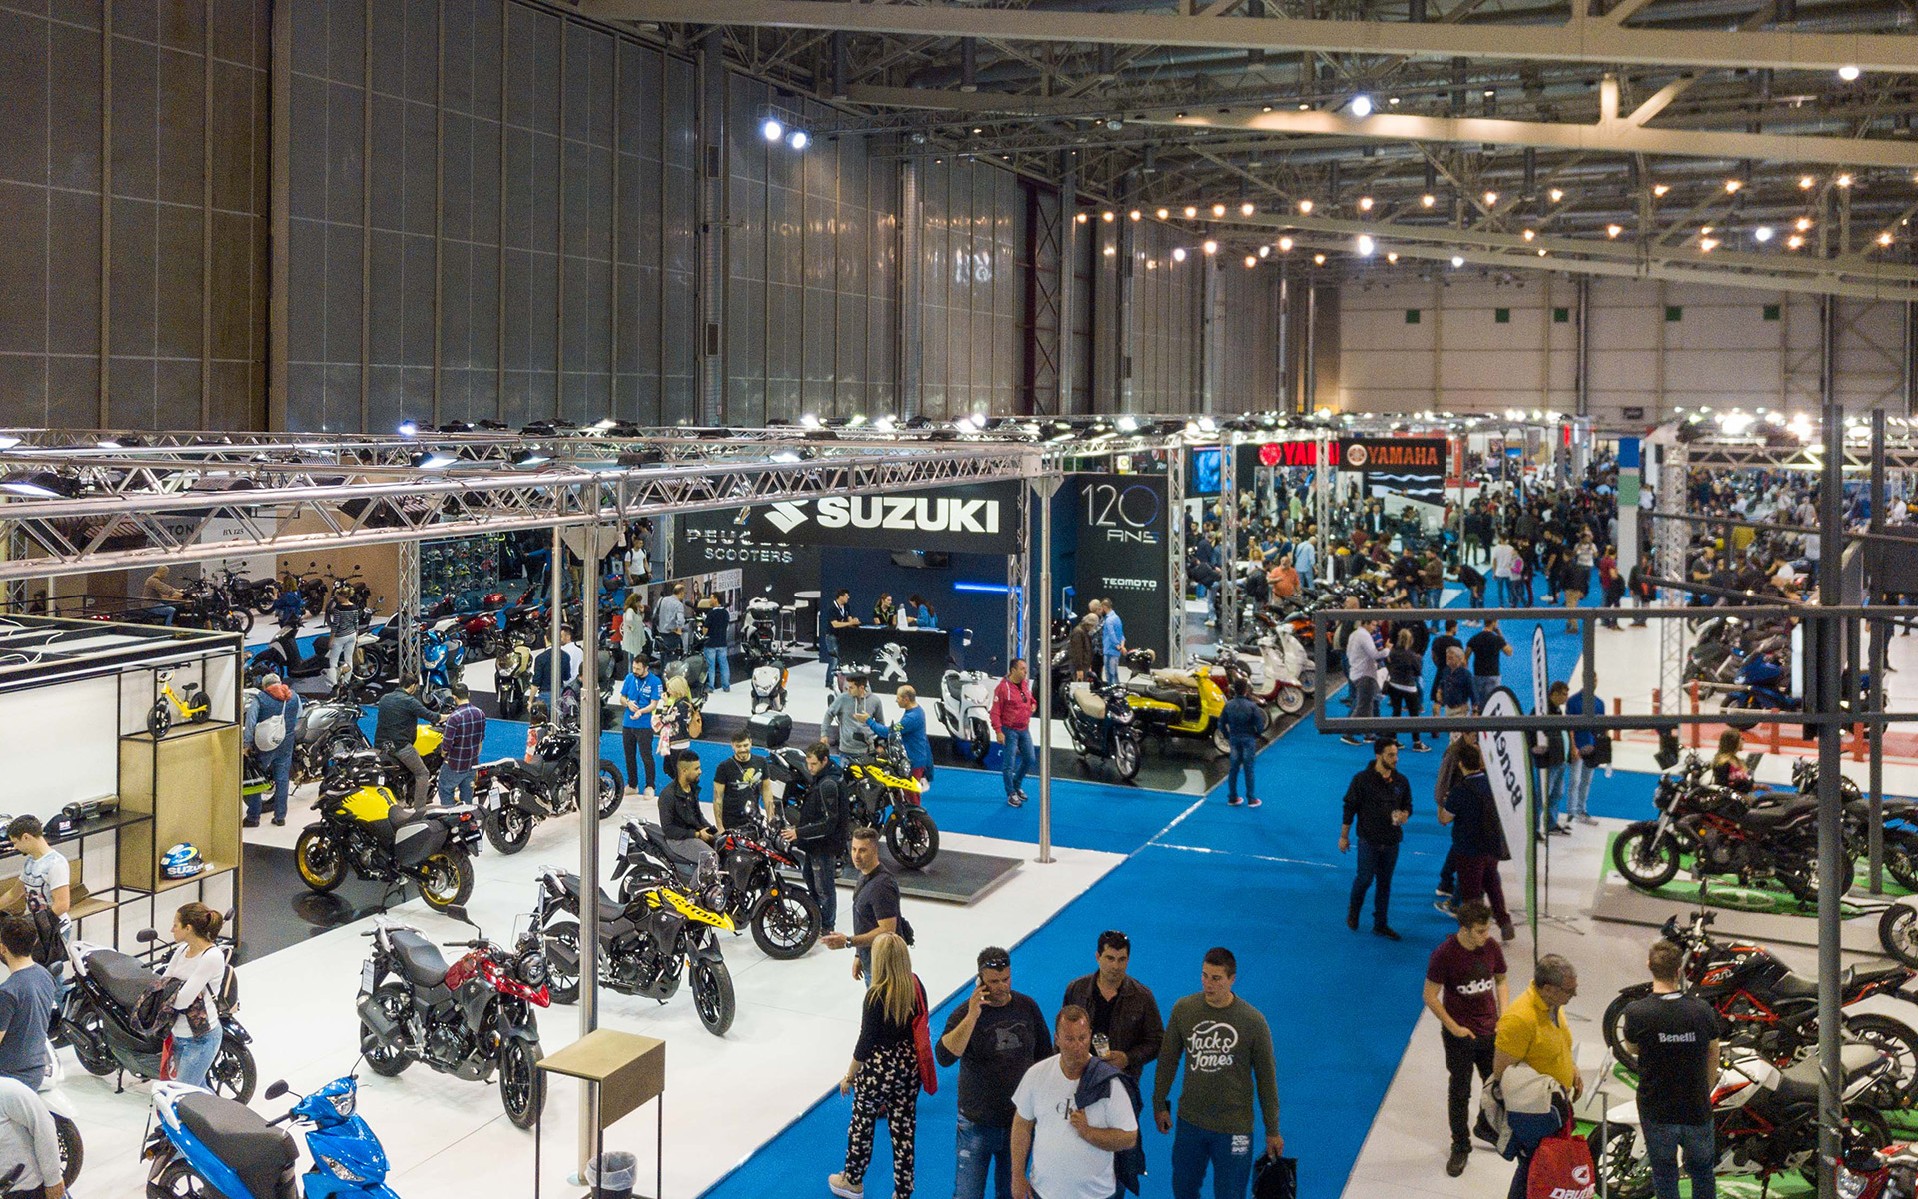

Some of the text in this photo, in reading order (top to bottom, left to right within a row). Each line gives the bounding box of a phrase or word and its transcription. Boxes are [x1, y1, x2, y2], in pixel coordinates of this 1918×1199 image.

[1367, 445, 1439, 466] YAMAHA
[817, 496, 999, 533] SUZUKI
[1082, 484, 1159, 527] 120
[704, 547, 793, 563] SCOOTERS
[1187, 1031, 1221, 1053] Jack
[1658, 1032, 1696, 1042] Benelli
[1190, 1050, 1235, 1071] Jones
